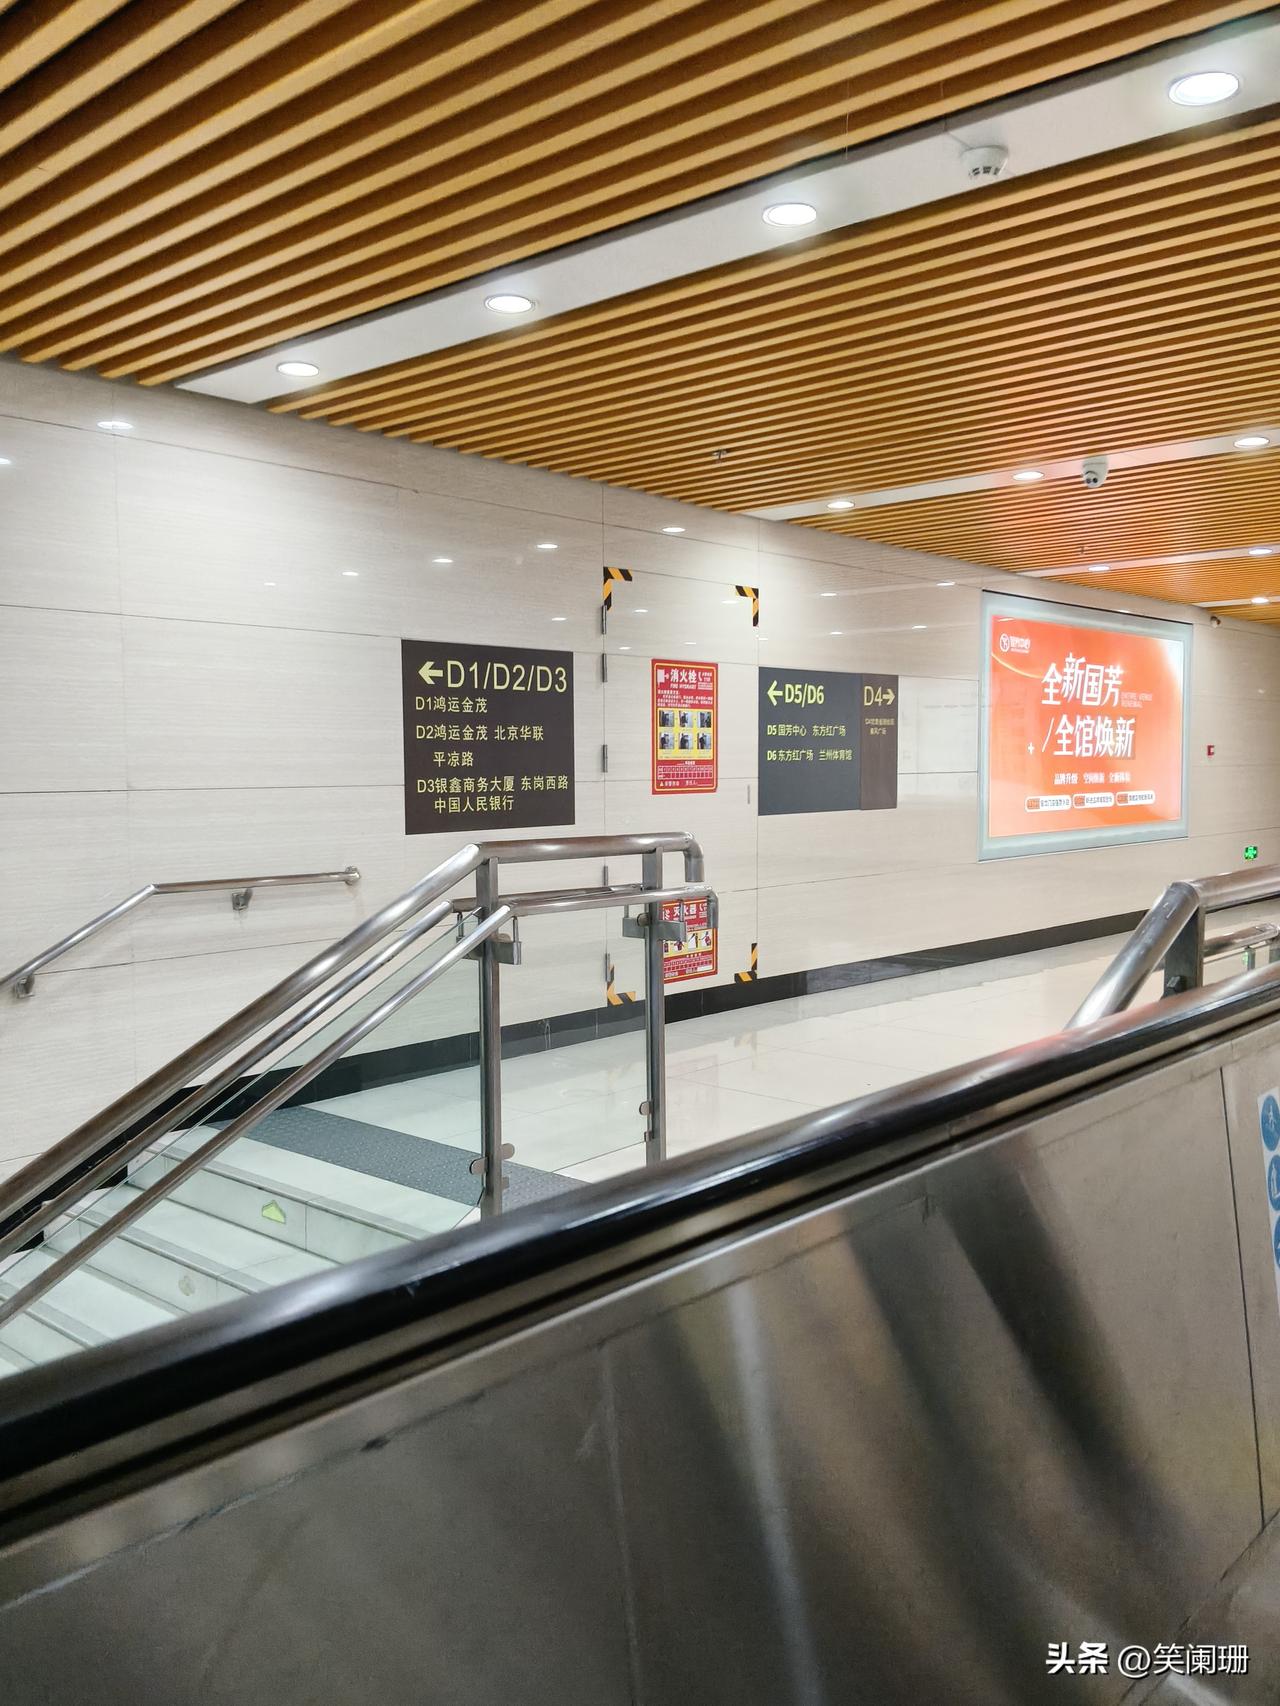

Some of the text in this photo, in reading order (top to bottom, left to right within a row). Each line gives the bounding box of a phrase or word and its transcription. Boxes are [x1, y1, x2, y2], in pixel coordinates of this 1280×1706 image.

[447, 660, 567, 693] D1/D2/D3
[670, 668, 697, 683] 消火栓
[1041, 652, 1124, 707] 全新国芳
[785, 683, 824, 708] D5/D6
[863, 686, 883, 706] D4
[415, 696, 488, 713] D1鸿运金茂
[416, 724, 544, 741] D2鸿运金茂 北京华联
[812, 725, 846, 737] 东方红广场
[433, 751, 474, 767] 平凉路
[819, 749, 853, 761] 兰州体育馆
[417, 775, 568, 793] D3银鑫商务大厦 东岗西路
[434, 795, 514, 814] 中国人民银行
